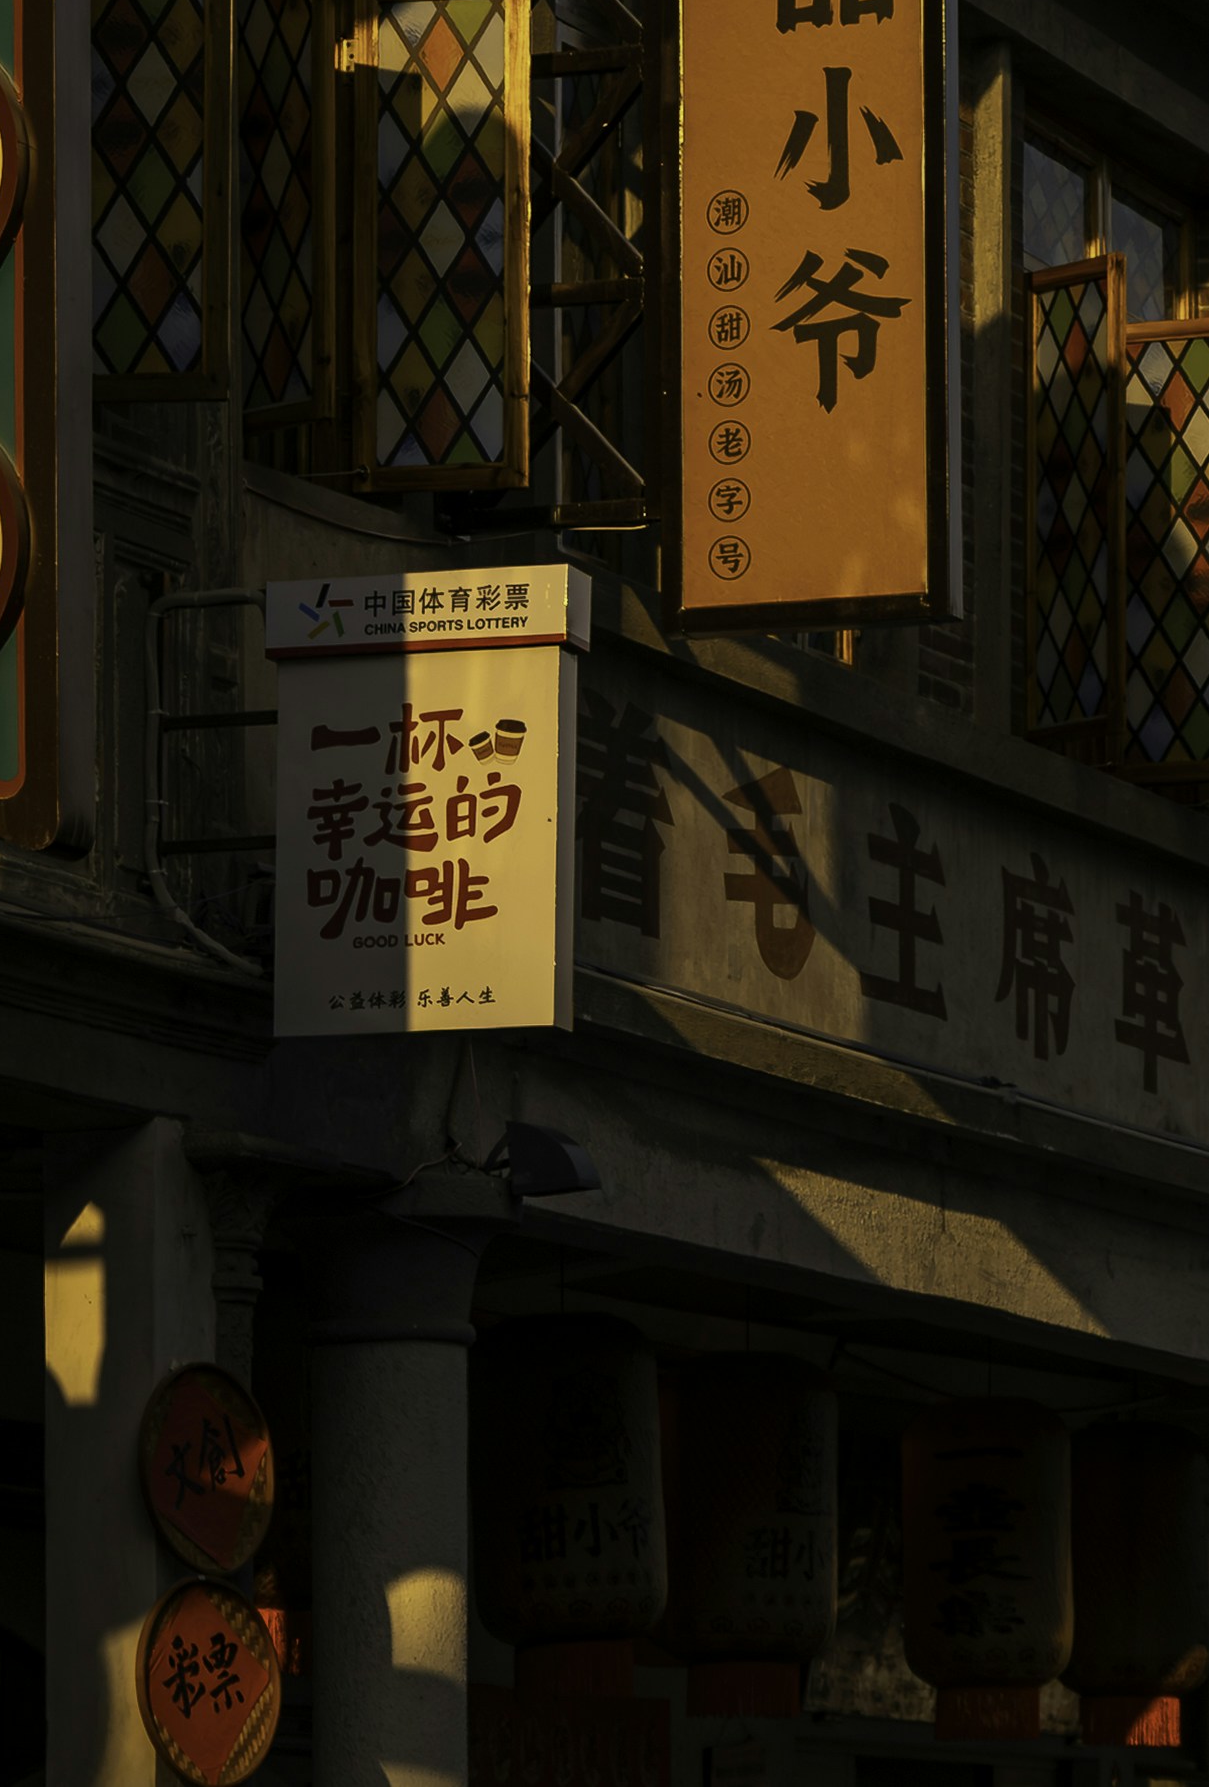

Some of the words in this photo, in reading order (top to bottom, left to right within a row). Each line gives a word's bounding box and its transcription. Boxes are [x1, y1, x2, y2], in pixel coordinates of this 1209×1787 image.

[710, 193, 748, 578] 潮汕甜汤老字号
[364, 583, 530, 618] 中国体育彩票
[364, 623, 406, 635] CHINA
[409, 619, 463, 632] SPORTS
[467, 616, 528, 630] LOTTERY
[310, 703, 465, 775] 一杯
[307, 772, 523, 861] 幸运的
[307, 856, 498, 940] 咖啡
[353, 935, 398, 949] GOOD
[405, 933, 445, 947] LUCK
[328, 990, 406, 1011] 公益体彩
[417, 986, 496, 1008] 乐善人生
[162, 1632, 245, 1719] 彩票
